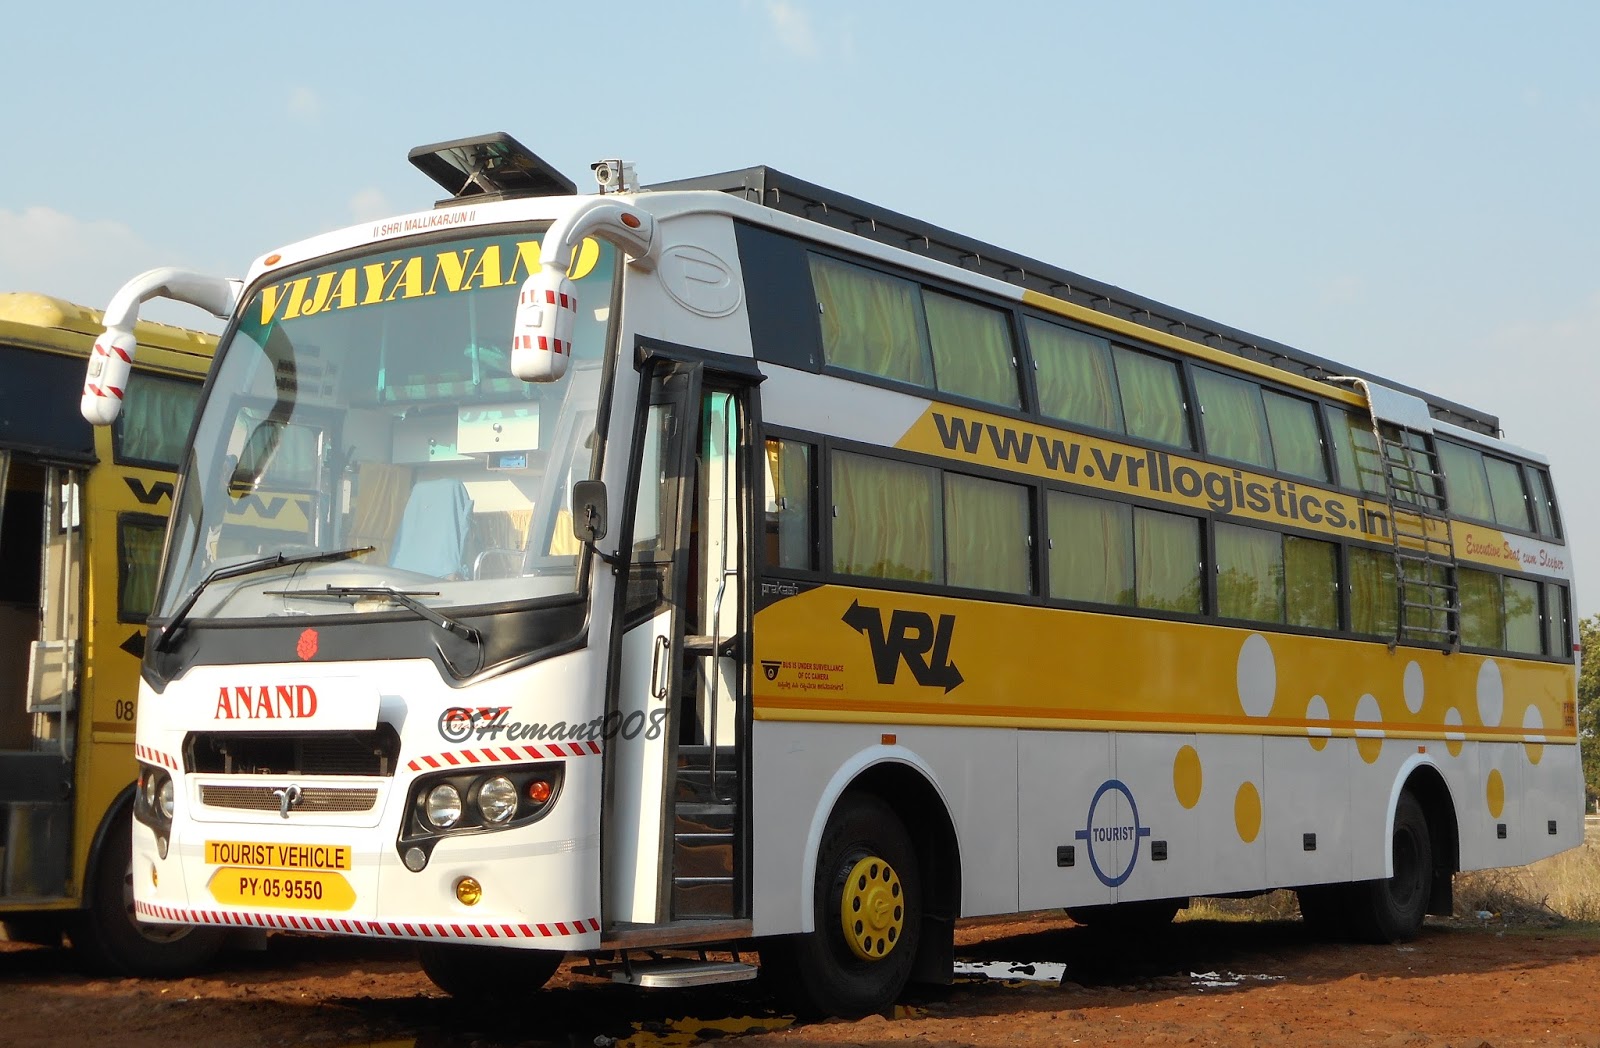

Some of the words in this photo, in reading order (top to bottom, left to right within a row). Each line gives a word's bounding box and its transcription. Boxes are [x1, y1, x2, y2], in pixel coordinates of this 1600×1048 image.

[381, 222, 403, 237] SHRI
[404, 211, 467, 232] MALLIKARJUN
[932, 412, 1390, 538] www.vrllogistics.in
[1466, 533, 1501, 558] Executive
[1503, 541, 1520, 562] Seat
[1523, 552, 1537, 565] cum
[1539, 549, 1565, 572] Sleeper
[841, 598, 964, 695] VRL
[782, 661, 792, 669] BUS
[798, 662, 812, 670] UNDER
[813, 663, 844, 672] SURVEILLANCE
[812, 673, 829, 681] CAMERA
[115, 699, 135, 721] 08
[213, 684, 318, 720] ANAND
[1093, 826, 1135, 842] TOURIST
[211, 843, 275, 866] TOURIST
[279, 846, 345, 868] VEHICLE
